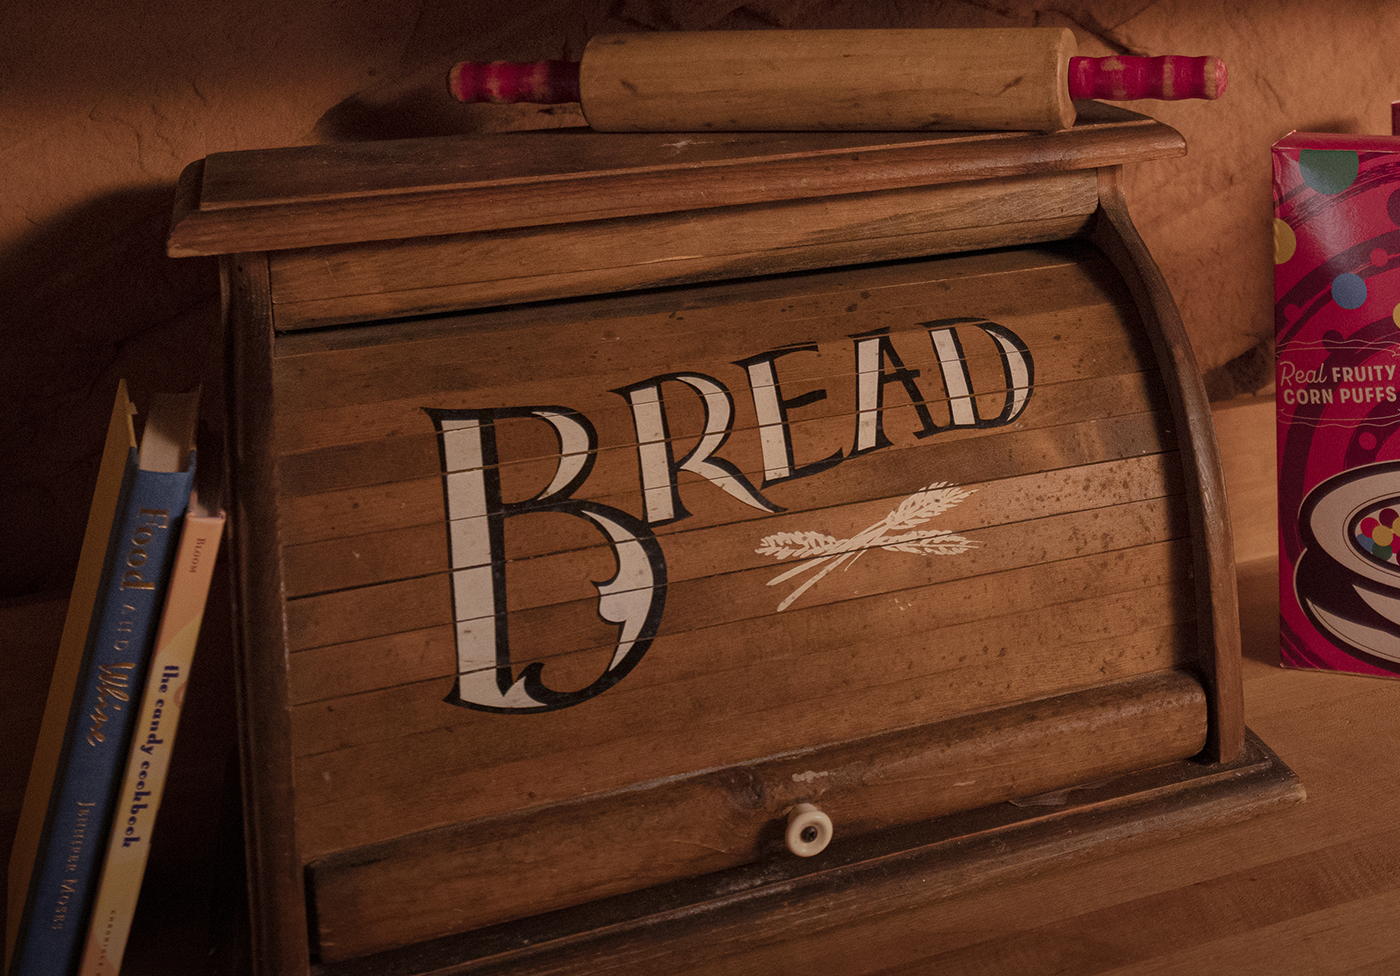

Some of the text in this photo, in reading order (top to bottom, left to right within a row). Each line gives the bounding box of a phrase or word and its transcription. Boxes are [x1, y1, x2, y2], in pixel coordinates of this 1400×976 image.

[1280, 361, 1396, 386] Real FRUITY
[1284, 386, 1397, 405] CORN PUFFS
[120, 508, 170, 591] Food
[189, 538, 206, 573] BLOOM
[421, 317, 1034, 714] BREAD
[87, 662, 136, 747] Whine
[122, 665, 179, 848] the candy cookbook
[52, 801, 96, 930] JENNIFER MOSES
[97, 910, 116, 966] CHRONICLE
